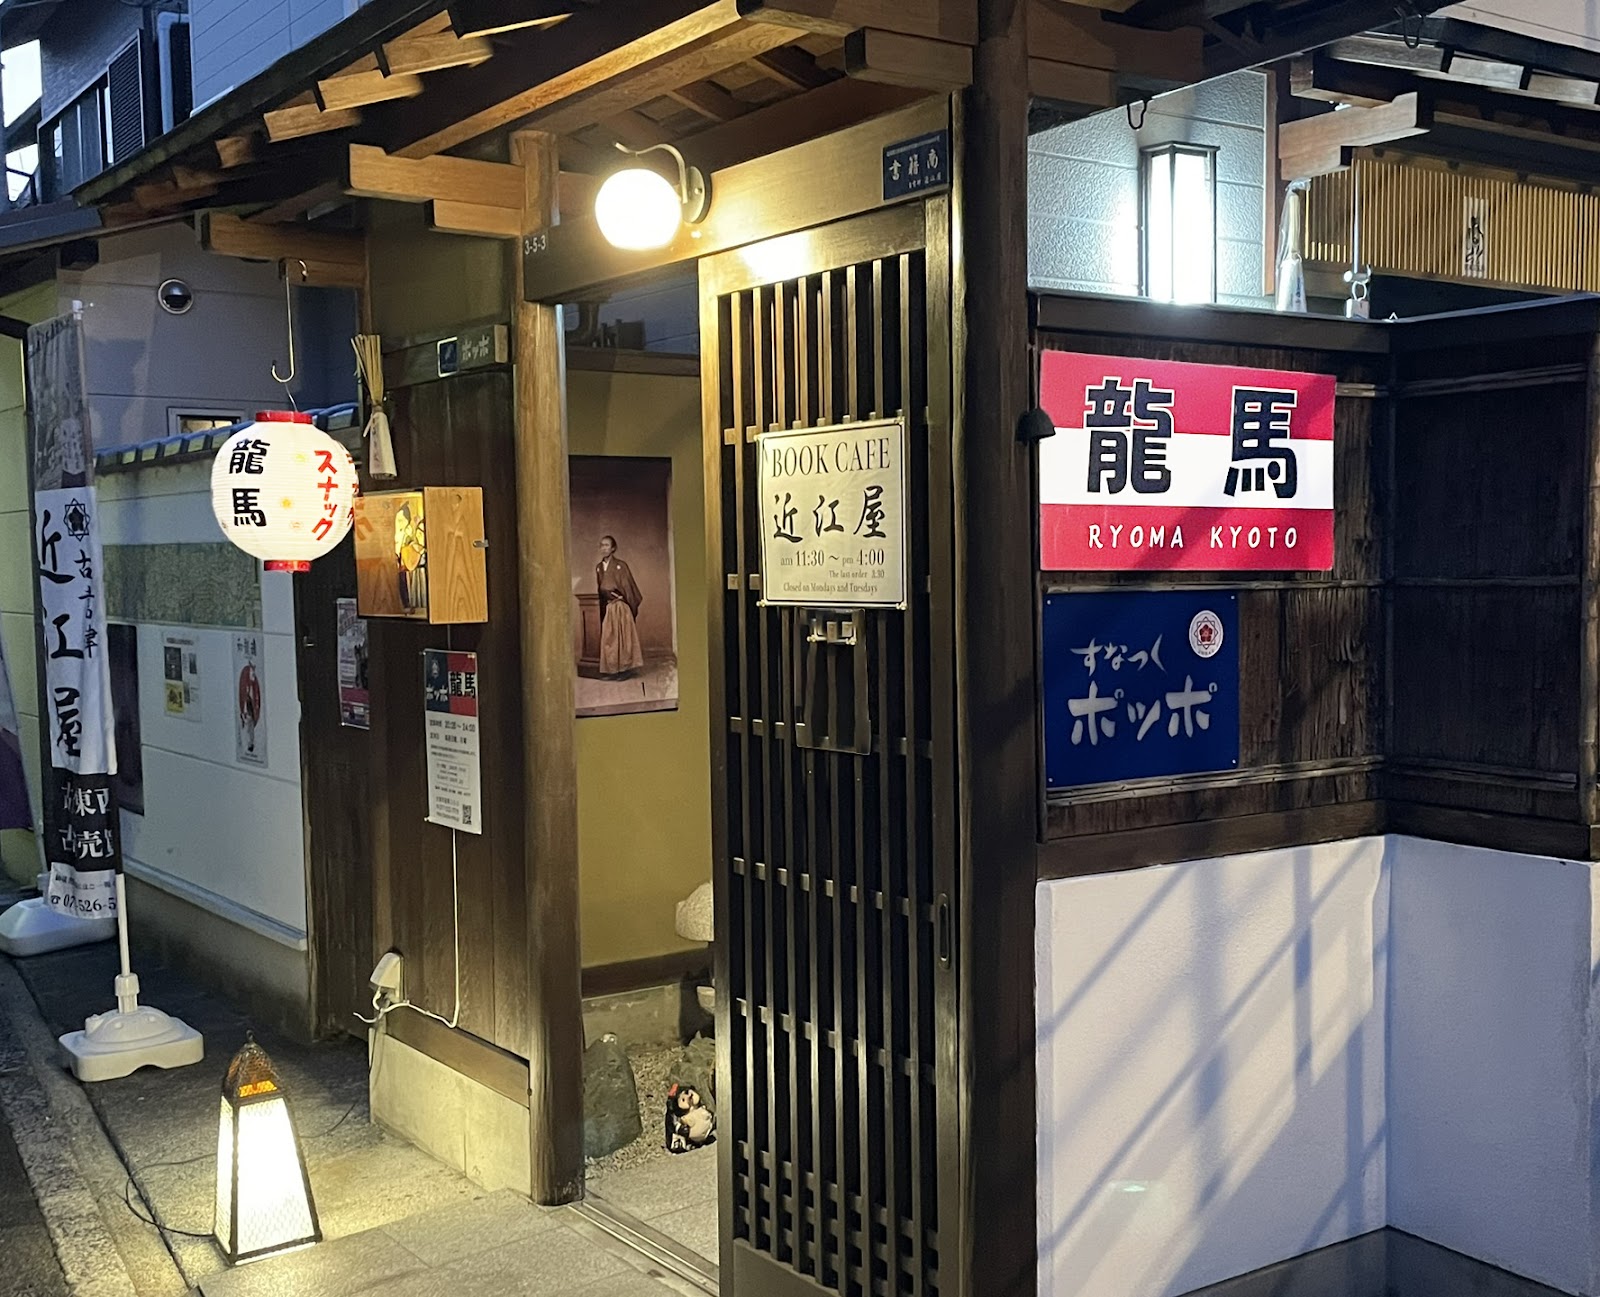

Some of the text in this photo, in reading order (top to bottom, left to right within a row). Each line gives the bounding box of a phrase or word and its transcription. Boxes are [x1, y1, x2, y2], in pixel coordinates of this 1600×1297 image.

[524, 234, 546, 255] 3-5-3
[772, 437, 892, 478] BOOK CAFE
[1083, 376, 1299, 499] 龍馬
[229, 438, 270, 528] 龍馬
[311, 449, 339, 541] スナック
[773, 485, 887, 543] 近江屋
[1088, 524, 1298, 550] RYOMA KYOTO
[780, 556, 793, 567] am
[796, 550, 825, 566] 11:30
[842, 557, 854, 568] pm
[856, 548, 885, 566] 4:00
[829, 570, 839, 579] The
[840, 570, 851, 579] last
[852, 569, 867, 578] order
[783, 582, 802, 593] Closed
[811, 582, 836, 595] Mondays
[837, 582, 848, 592] and
[849, 581, 878, 596] Tuesdays
[1070, 633, 1168, 677] すなっく
[450, 671, 476, 699] 龍馬
[1068, 674, 1218, 746] ポッポ
